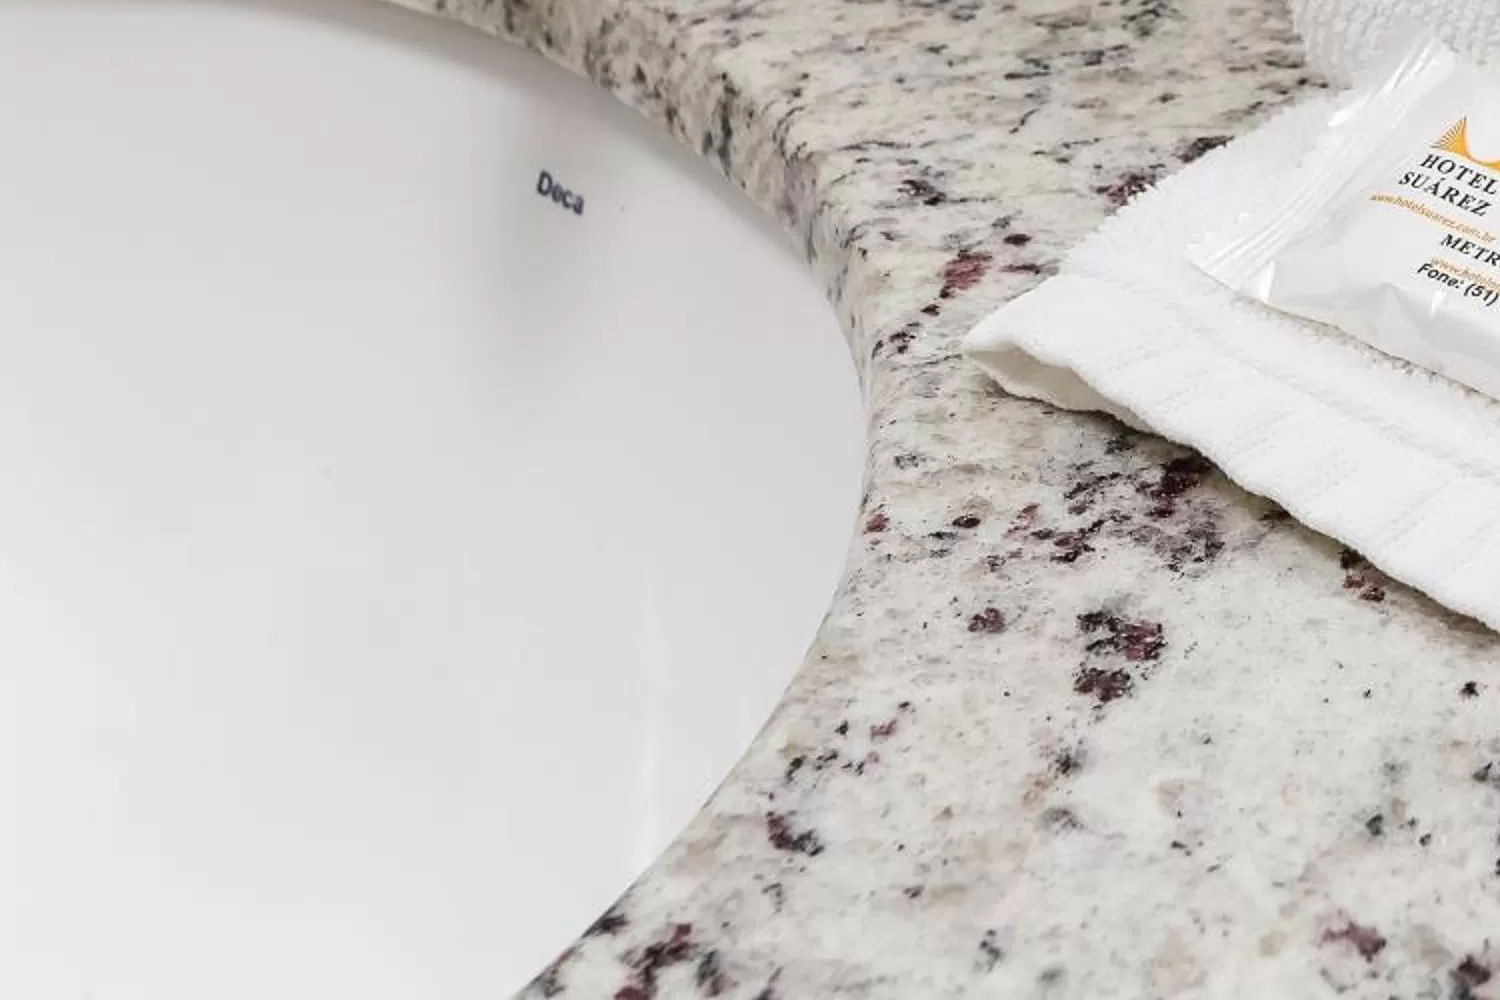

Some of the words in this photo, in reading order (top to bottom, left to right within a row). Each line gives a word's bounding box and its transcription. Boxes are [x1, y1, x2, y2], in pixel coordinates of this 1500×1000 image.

[536, 168, 585, 216] Deca
[1398, 171, 1493, 217] SUÁREZ
[1420, 153, 1499, 195] HOTEL
[1417, 263, 1465, 289] Fone:
[1464, 283, 1500, 307] (51)
